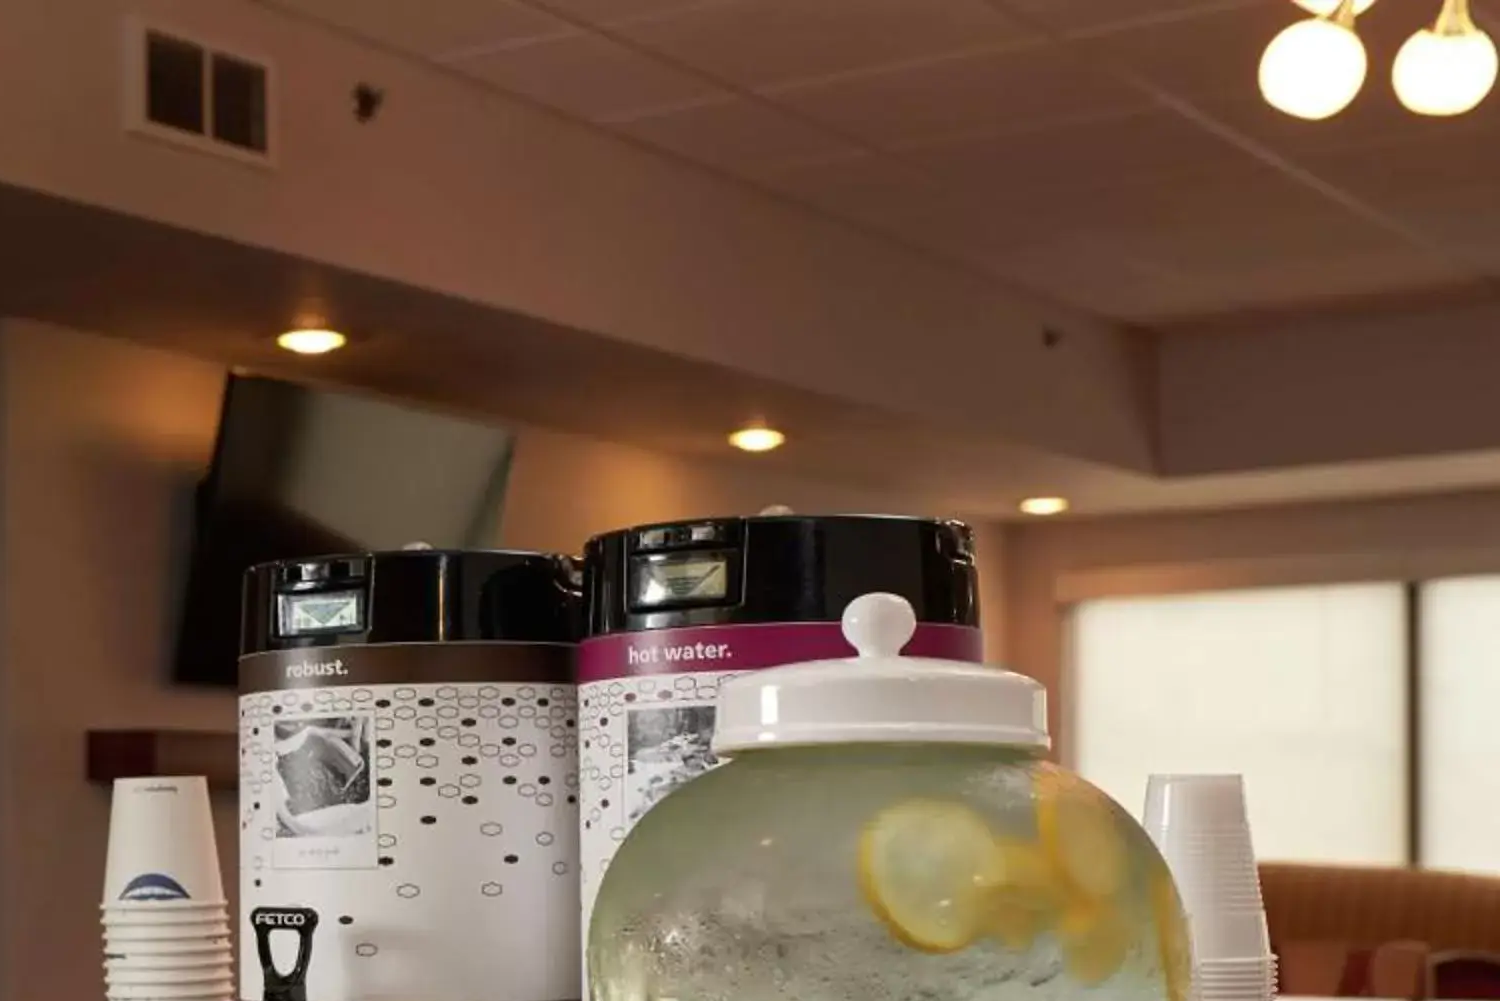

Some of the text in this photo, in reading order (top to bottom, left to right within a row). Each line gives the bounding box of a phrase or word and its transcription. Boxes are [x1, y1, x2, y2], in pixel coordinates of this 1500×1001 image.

[628, 641, 732, 664] hot water.
[286, 660, 348, 678] robust.
[255, 912, 305, 926] FETCO
